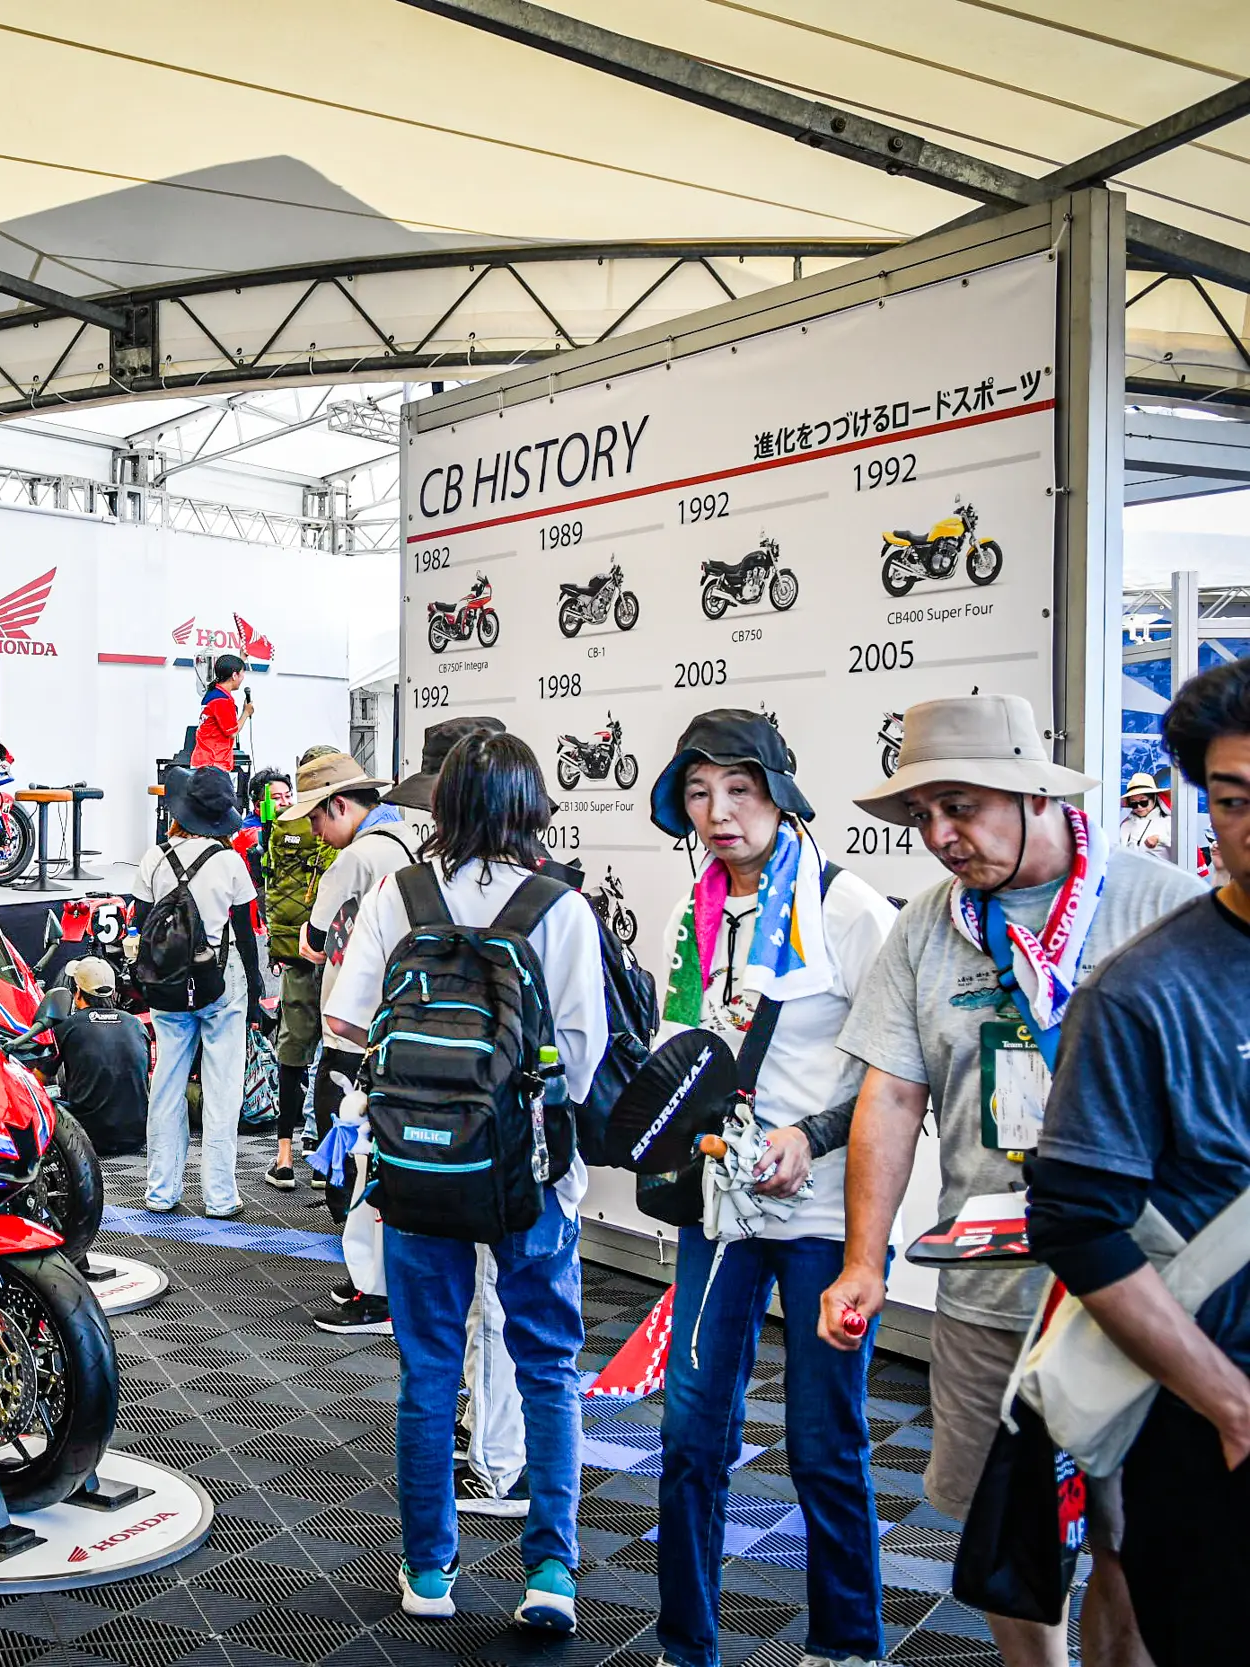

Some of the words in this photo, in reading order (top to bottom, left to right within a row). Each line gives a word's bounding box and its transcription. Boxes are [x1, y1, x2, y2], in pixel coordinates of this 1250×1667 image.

[753, 369, 1042, 461] 進化をつづけるロードスポーツ
[419, 463, 464, 518] CB
[472, 415, 650, 508] HISTORY
[853, 453, 917, 491] 1992
[678, 492, 730, 525] 1992
[539, 521, 583, 551] 1989
[414, 547, 450, 574] 1982
[887, 610, 924, 626] CB400
[927, 607, 962, 622] Super
[965, 603, 994, 618] Four
[196, 628, 242, 650] HON
[731, 629, 763, 643] CB750
[438, 663, 463, 674] CB750F
[464, 661, 489, 673] Integra
[587, 648, 606, 659] CB-1
[849, 640, 914, 673] 2005
[538, 673, 582, 700] 1998
[674, 659, 727, 689] 2003
[413, 685, 449, 709] 1992
[559, 802, 589, 812] CB1300
[590, 800, 614, 813] Super
[615, 800, 635, 812] Four
[846, 826, 913, 855] 2014
[96, 905, 119, 944] 5
[1002, 1040, 1023, 1049] Team
[631, 1045, 713, 1161] SPORTMAX
[88, 1512, 180, 1552] HONDA
